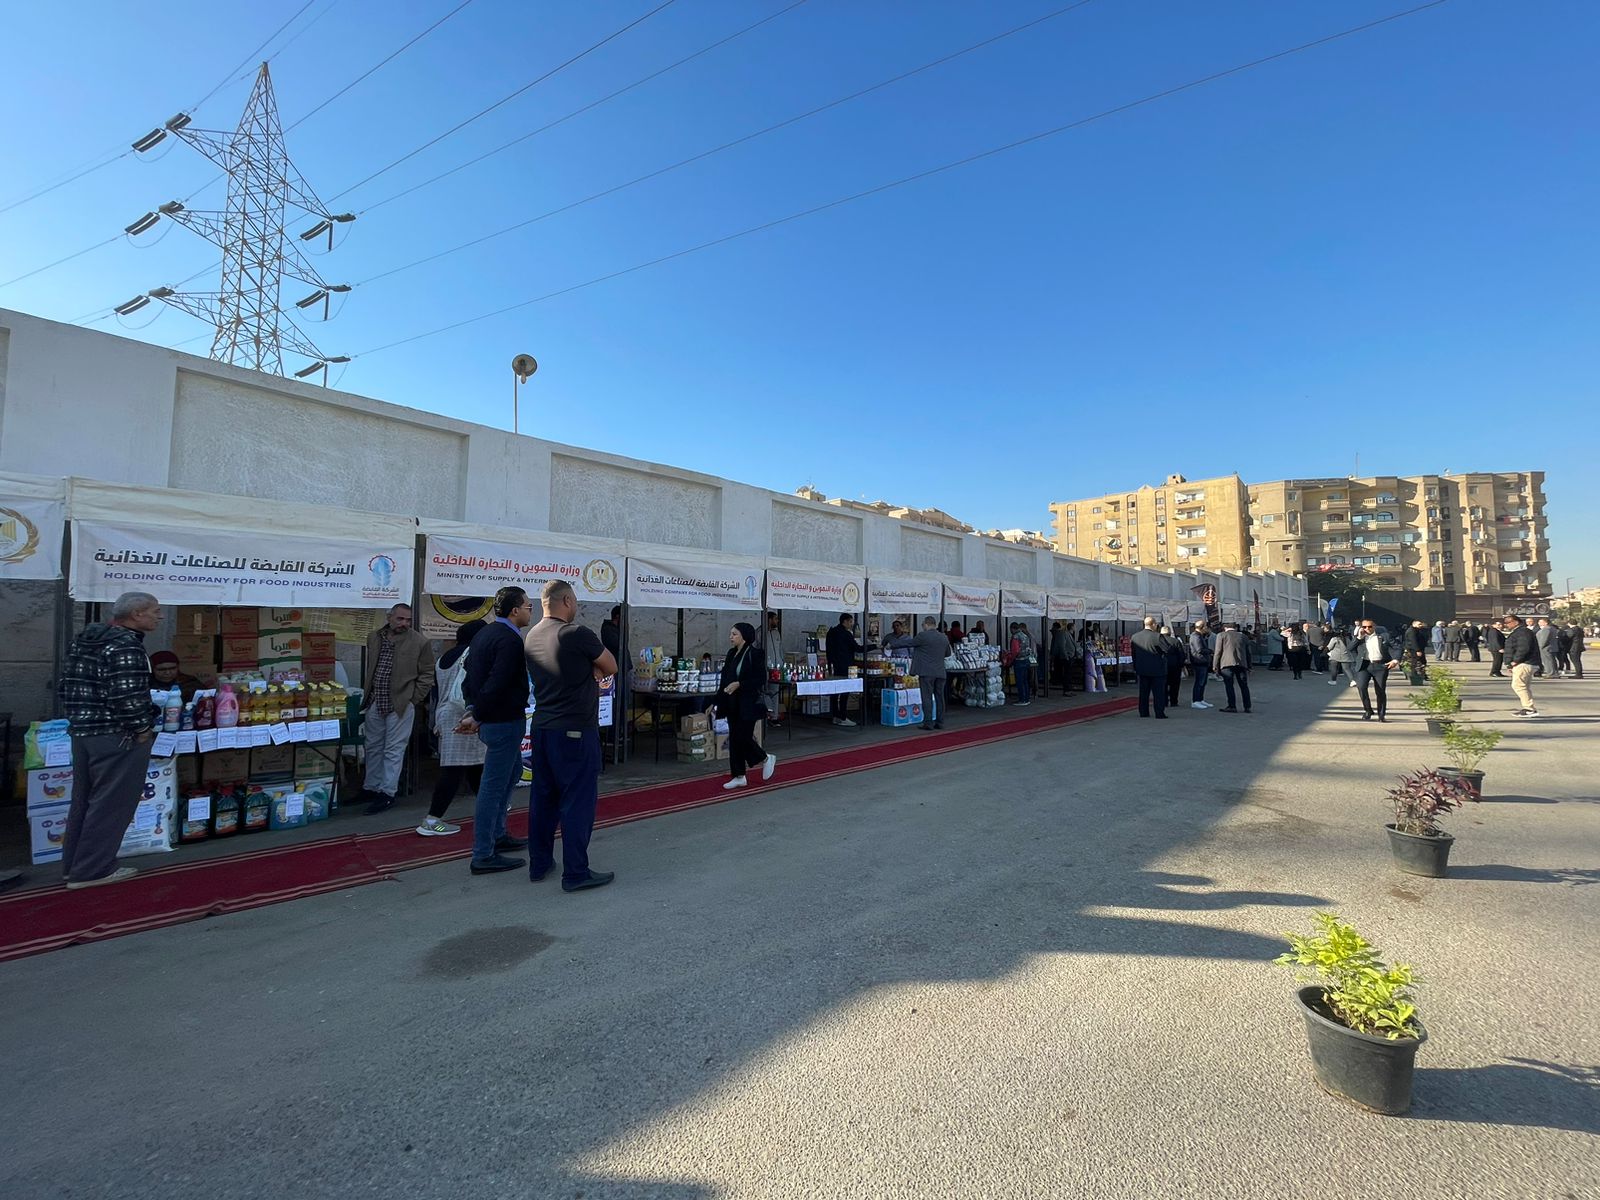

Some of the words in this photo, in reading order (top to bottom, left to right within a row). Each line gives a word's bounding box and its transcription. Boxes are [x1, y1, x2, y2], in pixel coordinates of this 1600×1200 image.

[94, 548, 168, 566] الغذائية
[171, 555, 247, 570] للصناعات
[433, 553, 476, 567] الداخلية
[478, 557, 512, 571] التجارة
[250, 558, 305, 575] القابضة
[308, 561, 355, 577] الشركة
[513, 562, 520, 572] و
[521, 563, 558, 574] التموين
[560, 564, 580, 577] وزارة
[103, 572, 165, 581] HOLDING
[168, 575, 230, 584] COMPANY
[292, 580, 352, 589] INDUSTRIES
[436, 572, 475, 580] MINISTRY
